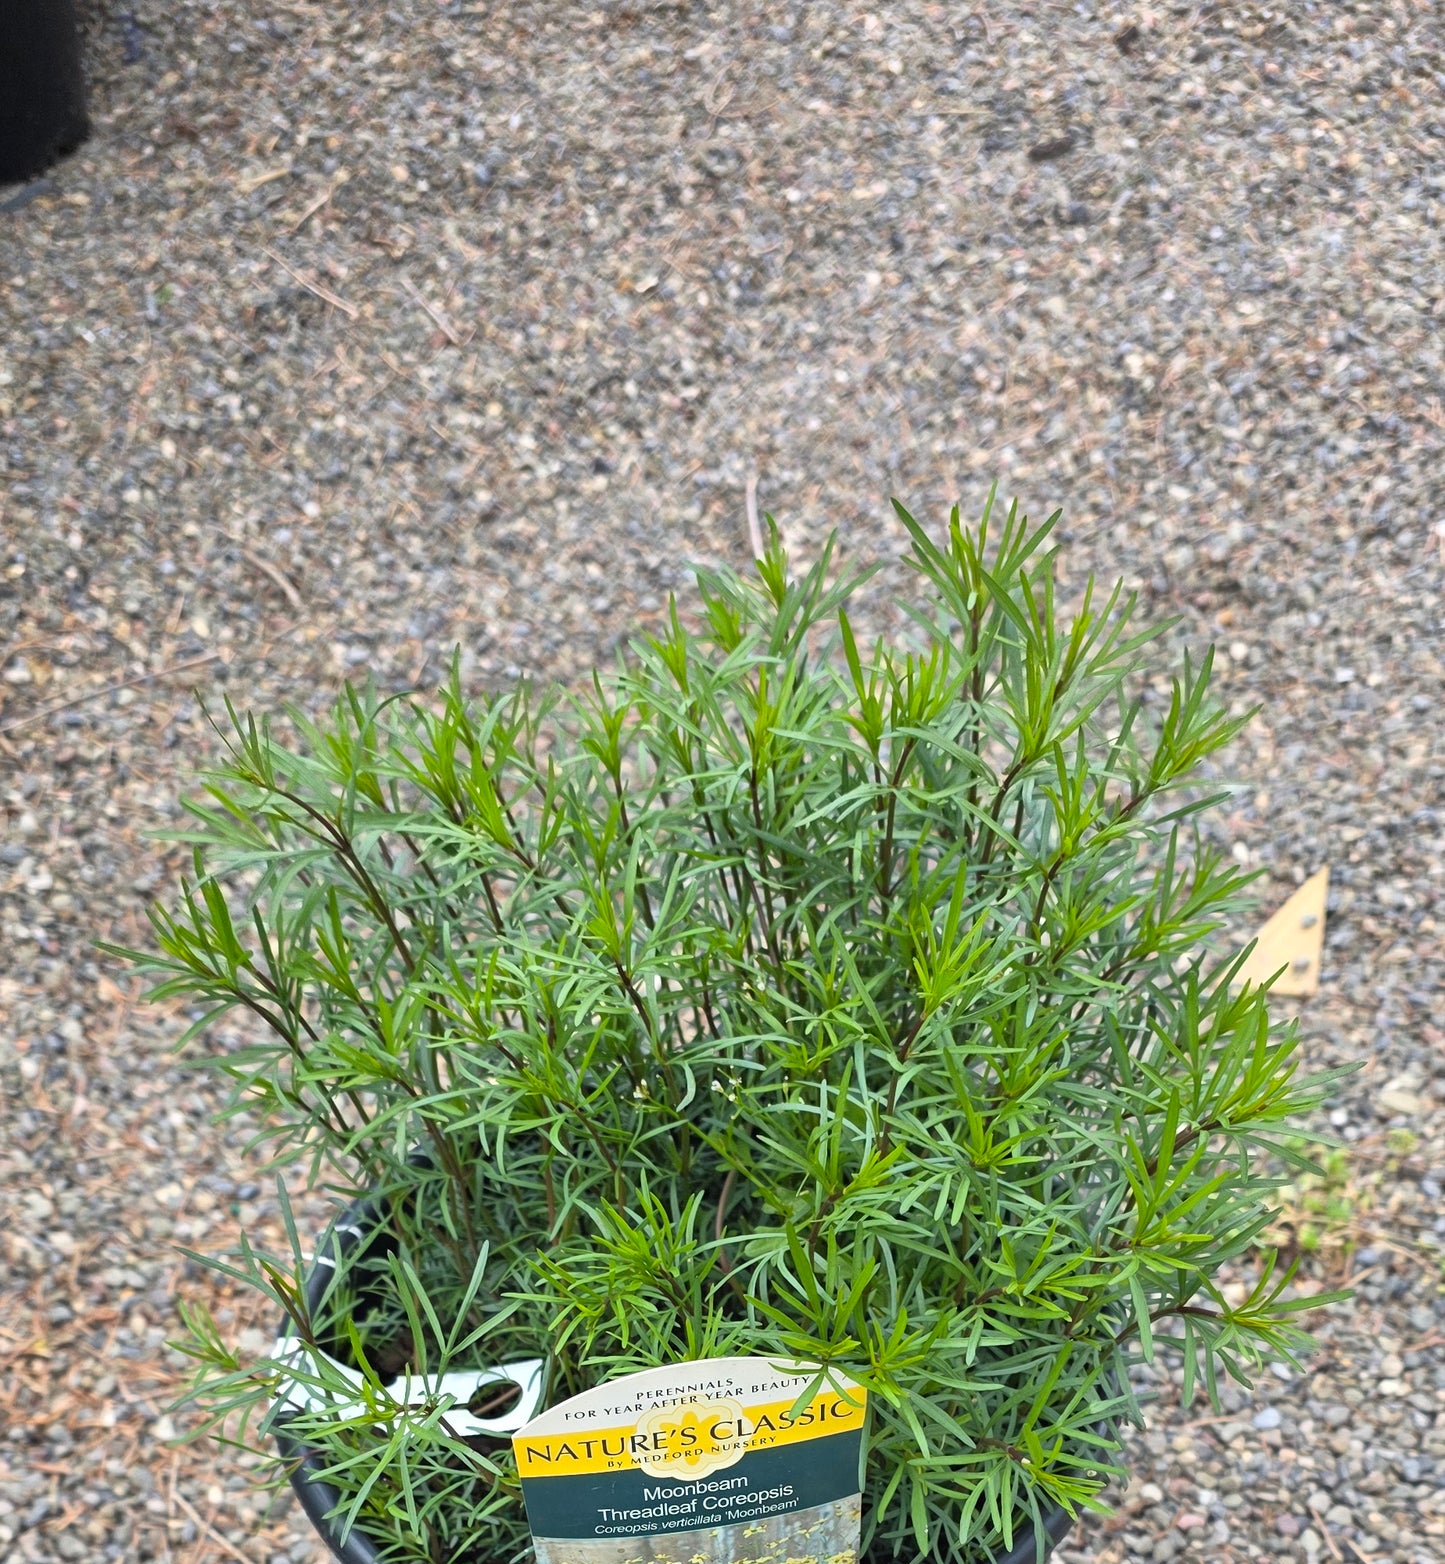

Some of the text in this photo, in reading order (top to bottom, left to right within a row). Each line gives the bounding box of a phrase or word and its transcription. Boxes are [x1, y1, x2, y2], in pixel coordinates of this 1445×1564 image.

[565, 1376, 811, 1421] FOR YEAR AFTER YEAR BEAUTY
[636, 1378, 734, 1400] PERENNIALS
[526, 1399, 854, 1464] NATURE'S CLASSIC
[631, 1448, 704, 1466] MEDFORD
[711, 1435, 777, 1453] NURSERY
[598, 1484, 794, 1523] Threadleaf Coreopsis
[643, 1474, 748, 1502] Moonbeam
[594, 1497, 800, 1535] Coreopsis verticillata 'Moonbeam'
